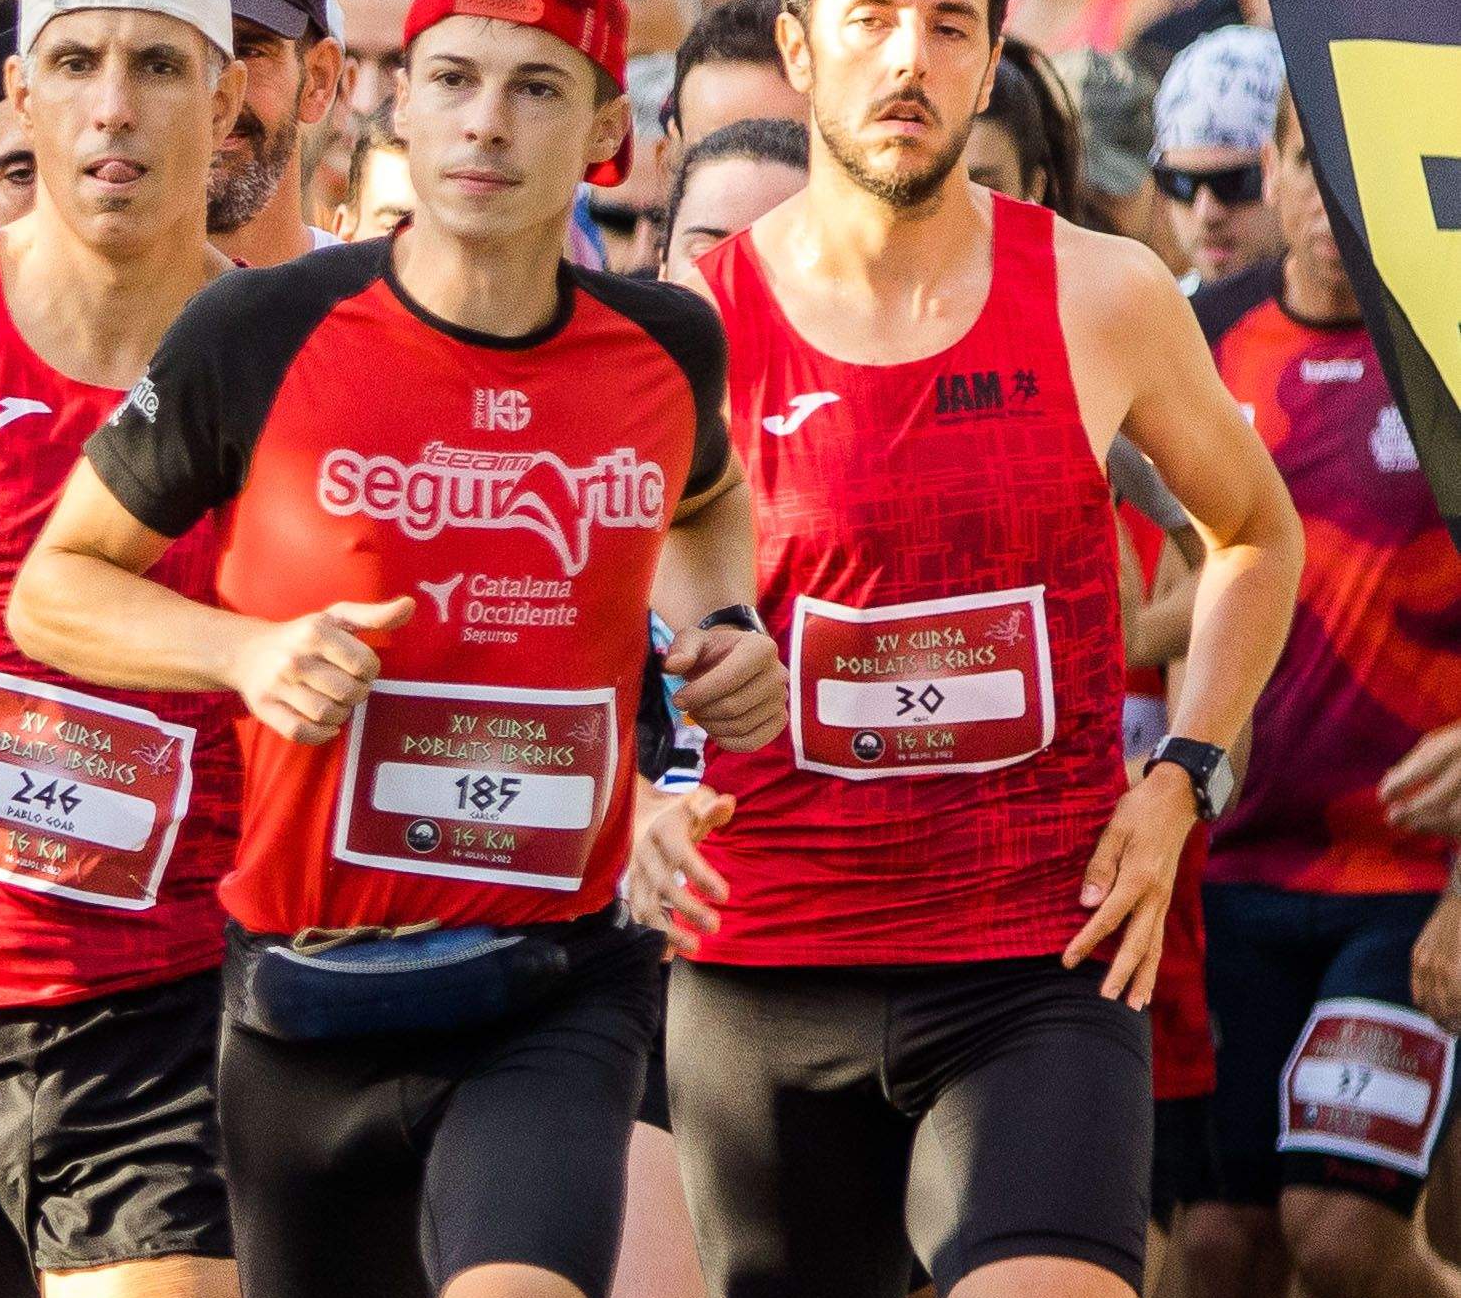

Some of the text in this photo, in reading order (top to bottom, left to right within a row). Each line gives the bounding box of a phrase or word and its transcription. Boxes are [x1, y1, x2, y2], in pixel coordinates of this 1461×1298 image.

[935, 370, 1003, 414] JAM
[423, 441, 534, 471] team
[468, 574, 572, 598] Catalana
[465, 600, 577, 627] Occidente
[462, 627, 518, 643] Seguros
[875, 627, 967, 654] XV CURSA
[834, 654, 917, 675] POBLATS
[896, 684, 945, 717] 30
[20, 710, 113, 753] XV CURSA
[451, 714, 547, 741] XV CURSA
[896, 731, 956, 750] 16 KM
[404, 735, 491, 762] POBLATS
[12, 770, 83, 815] 246
[455, 773, 522, 813] 185
[6, 805, 42, 823] PABLO
[6, 830, 67, 863] 16 KM
[452, 827, 516, 851] 16 KM
